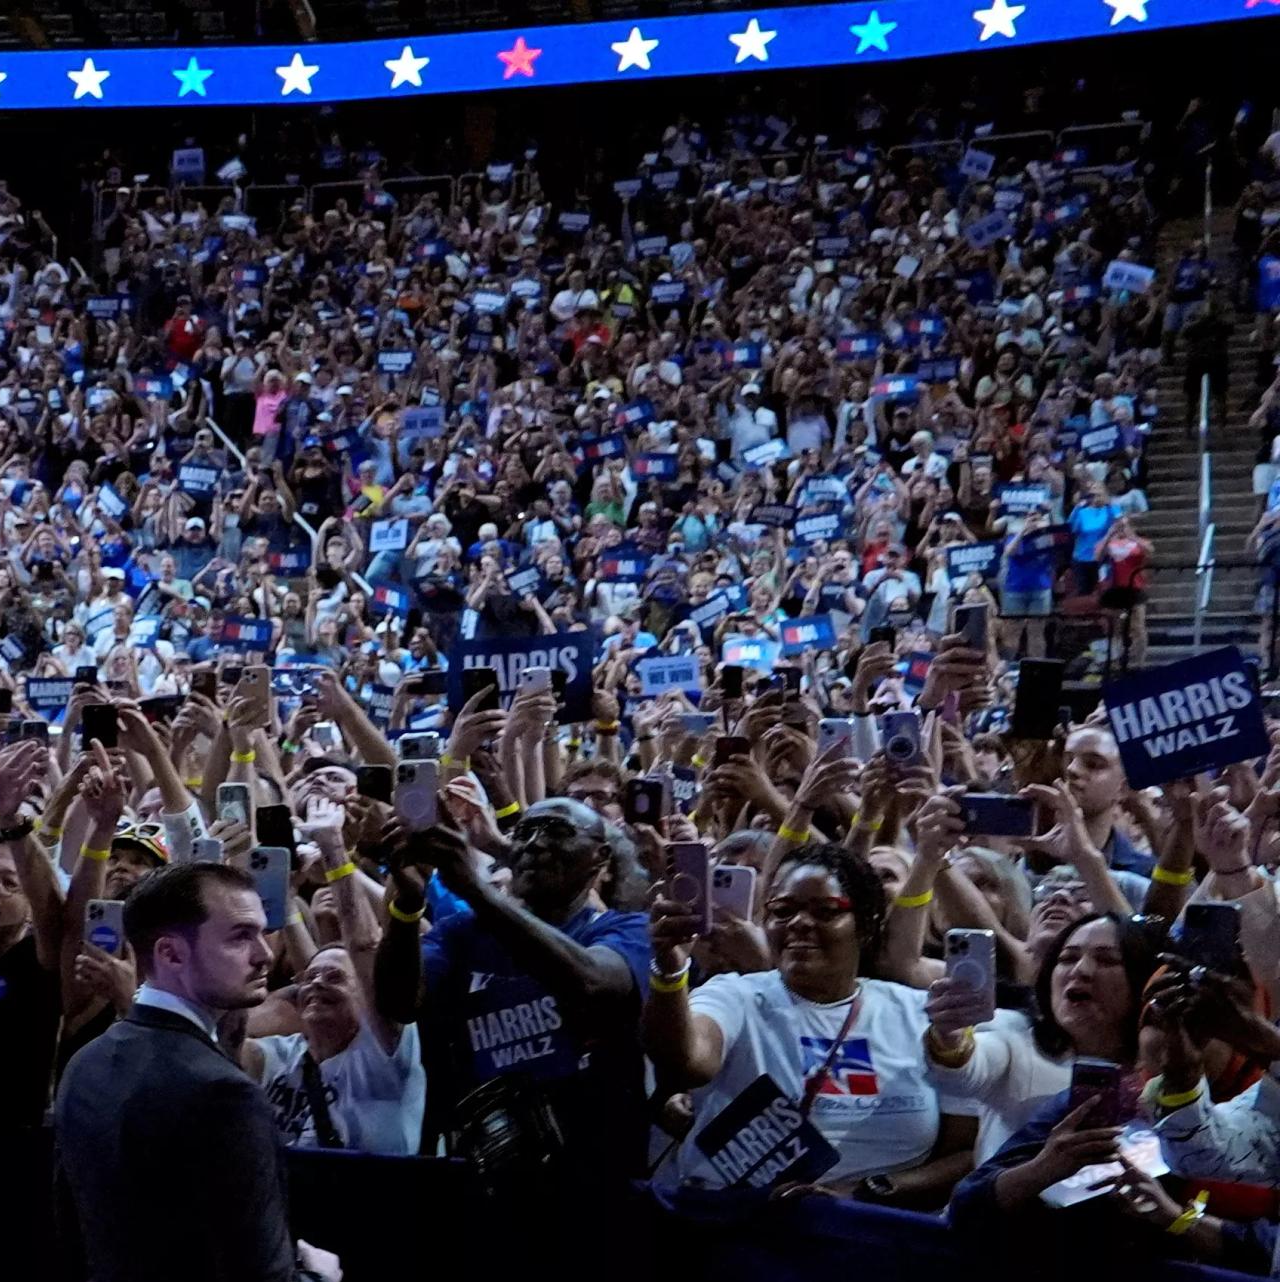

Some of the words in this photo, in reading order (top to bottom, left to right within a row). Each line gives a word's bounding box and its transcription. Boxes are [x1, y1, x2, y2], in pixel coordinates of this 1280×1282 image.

[1109, 671, 1252, 743] HARRIS
[1143, 714, 1240, 759] WALZ
[466, 995, 563, 1053] HARRIS
[491, 1035, 556, 1069] WALZ
[710, 1096, 804, 1186] HARRIS
[747, 1135, 810, 1188] WALZ
